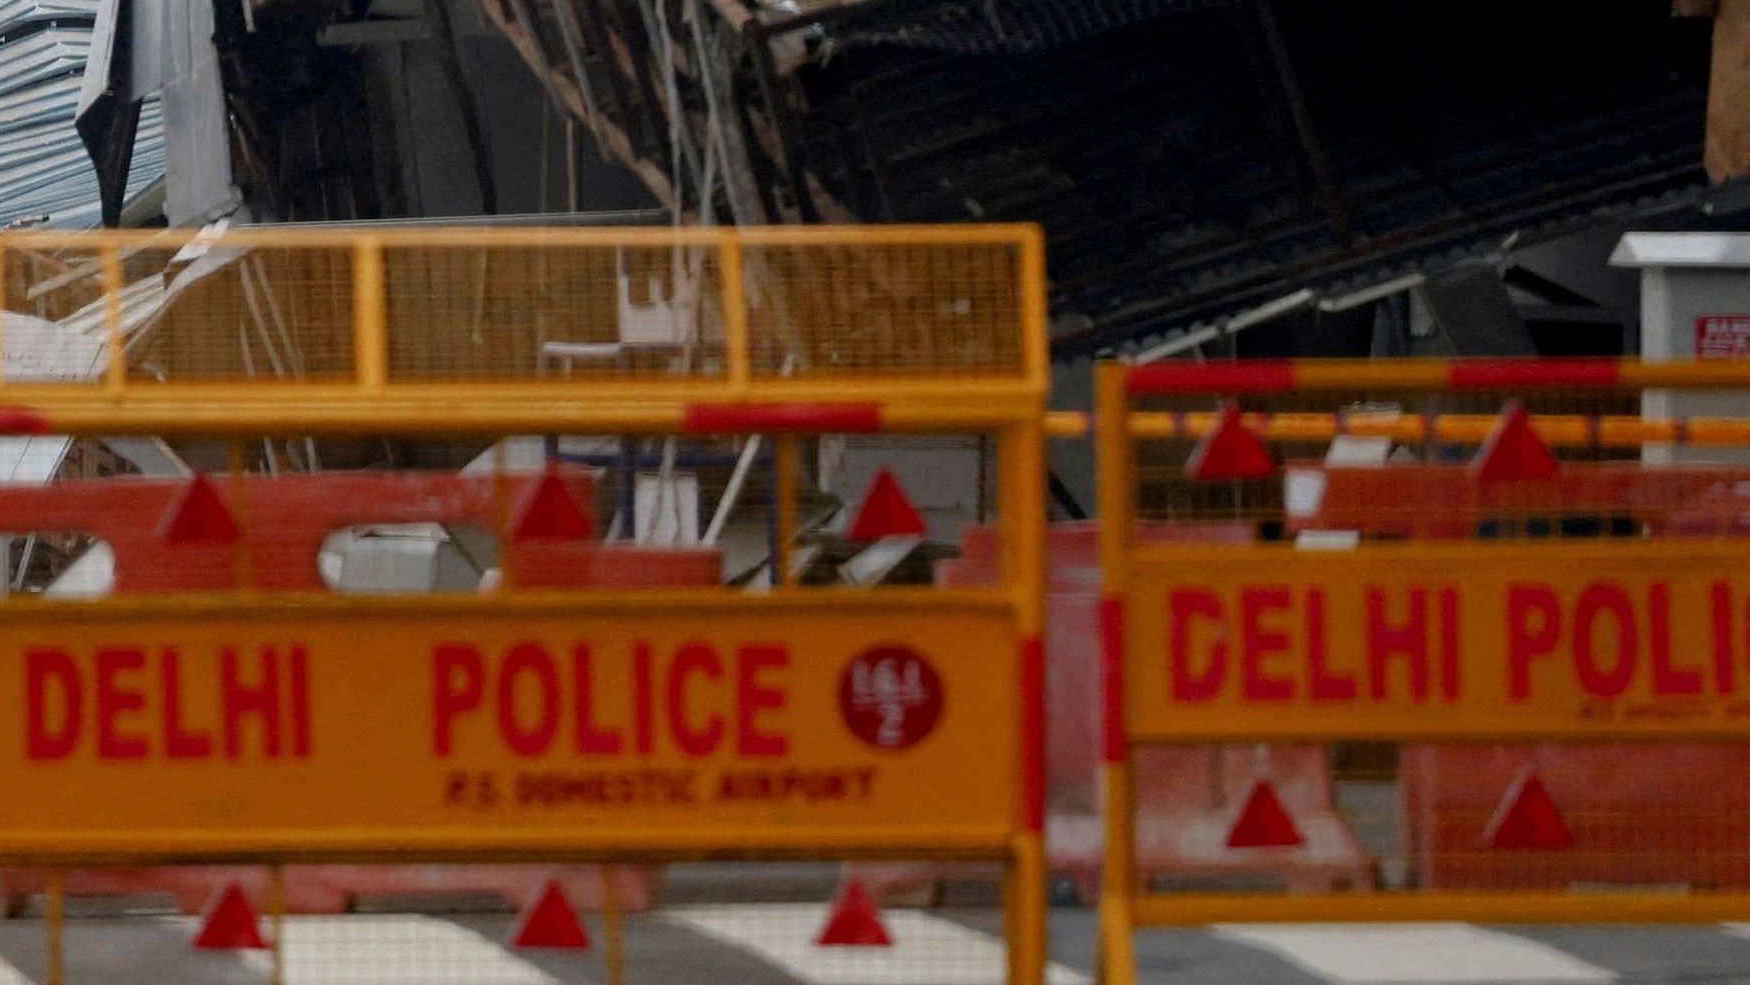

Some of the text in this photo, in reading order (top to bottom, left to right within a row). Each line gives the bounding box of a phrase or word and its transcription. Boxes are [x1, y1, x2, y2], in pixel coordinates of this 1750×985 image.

[1170, 580, 1750, 701] DELHI POLI
[26, 642, 789, 759] DELHI POLICE
[517, 769, 695, 805] DOMESTIC
[715, 766, 877, 802] AIRPORT
